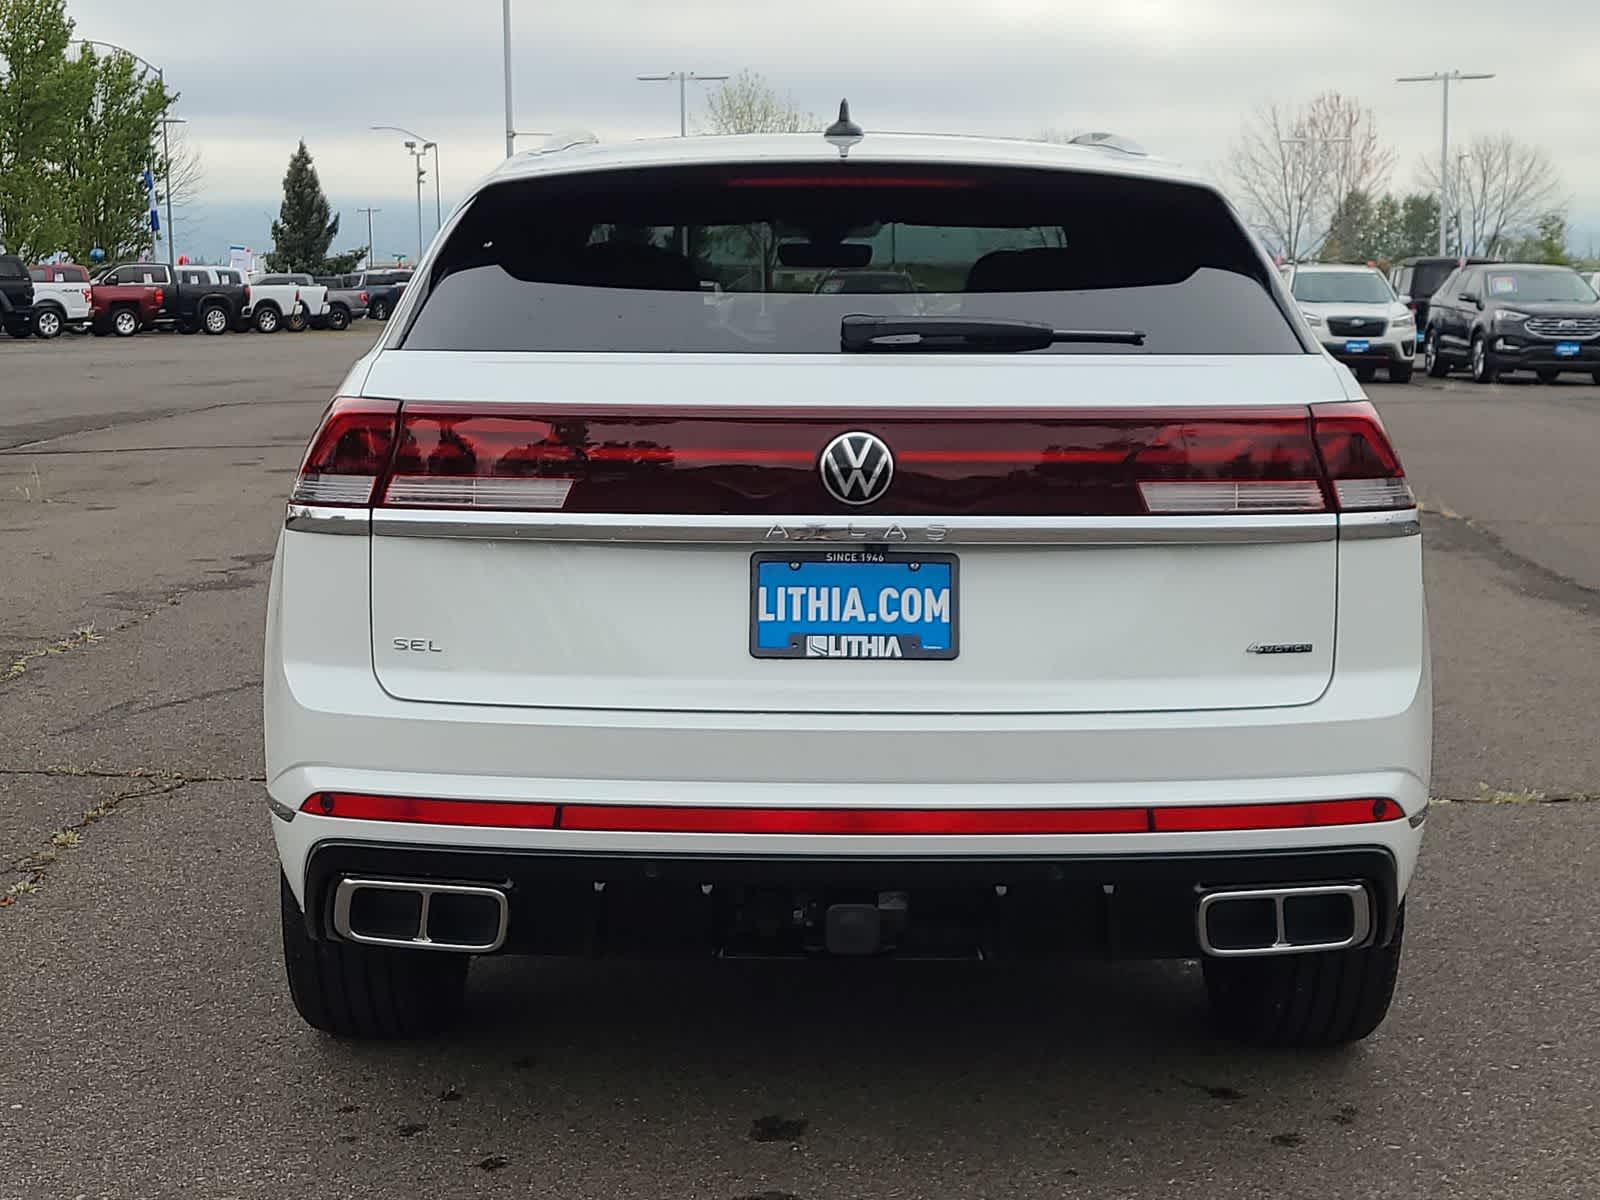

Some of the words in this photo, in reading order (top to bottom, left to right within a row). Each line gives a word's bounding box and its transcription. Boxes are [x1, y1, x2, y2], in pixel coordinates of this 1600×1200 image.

[765, 523, 948, 542] ATLAS
[826, 552, 858, 562] SINCE
[861, 553, 885, 563] 1946
[757, 585, 950, 624] LITHIA.COM
[393, 637, 443, 653] SEL
[828, 635, 903, 658] LITHIA
